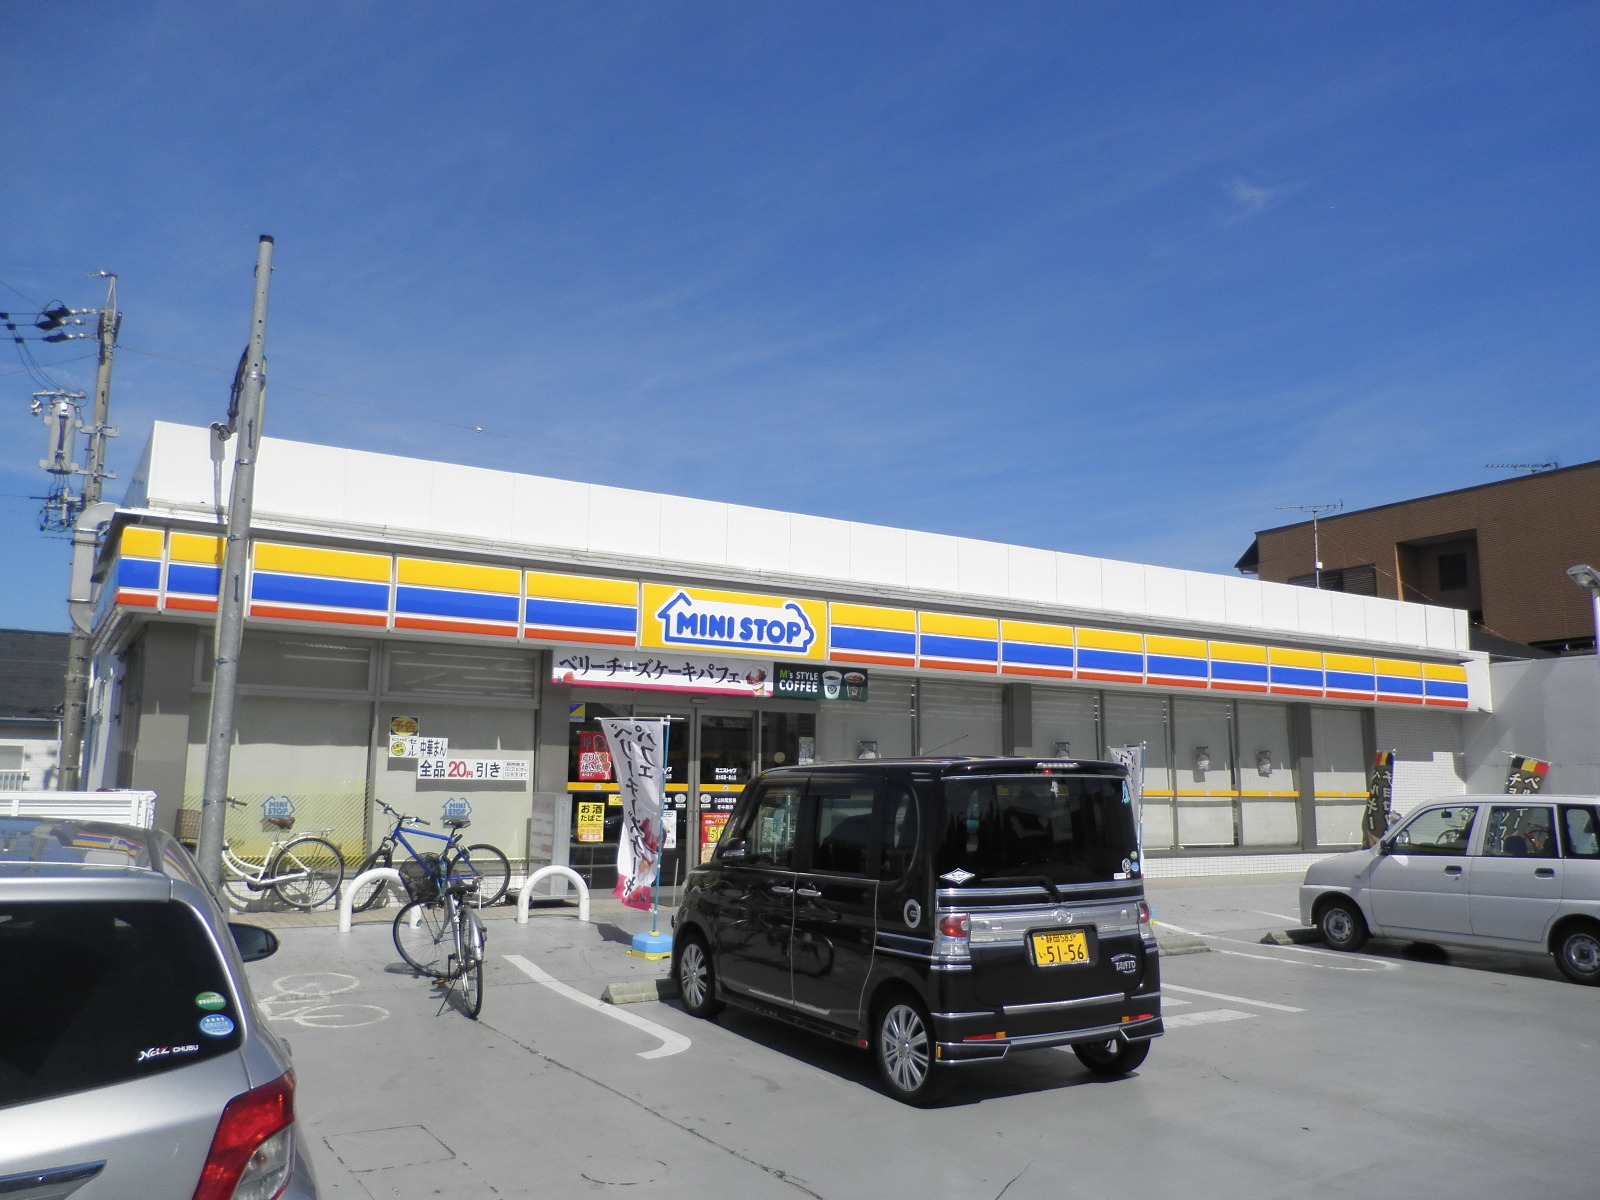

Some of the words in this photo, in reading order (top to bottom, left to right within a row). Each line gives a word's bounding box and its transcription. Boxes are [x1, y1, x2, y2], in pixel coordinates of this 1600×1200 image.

[676, 611, 735, 640] MINI
[739, 617, 802, 644] STOP
[559, 655, 742, 684] ベリーチーズケーキパフェ
[795, 671, 818, 680] STYLE
[779, 679, 818, 693] COFFEE
[420, 739, 447, 757] 中華まん
[580, 804, 604, 814] お酒
[580, 814, 603, 822] たばこ
[1115, 960, 1137, 971] TANTO
[172, 1044, 199, 1053] CHUBU
